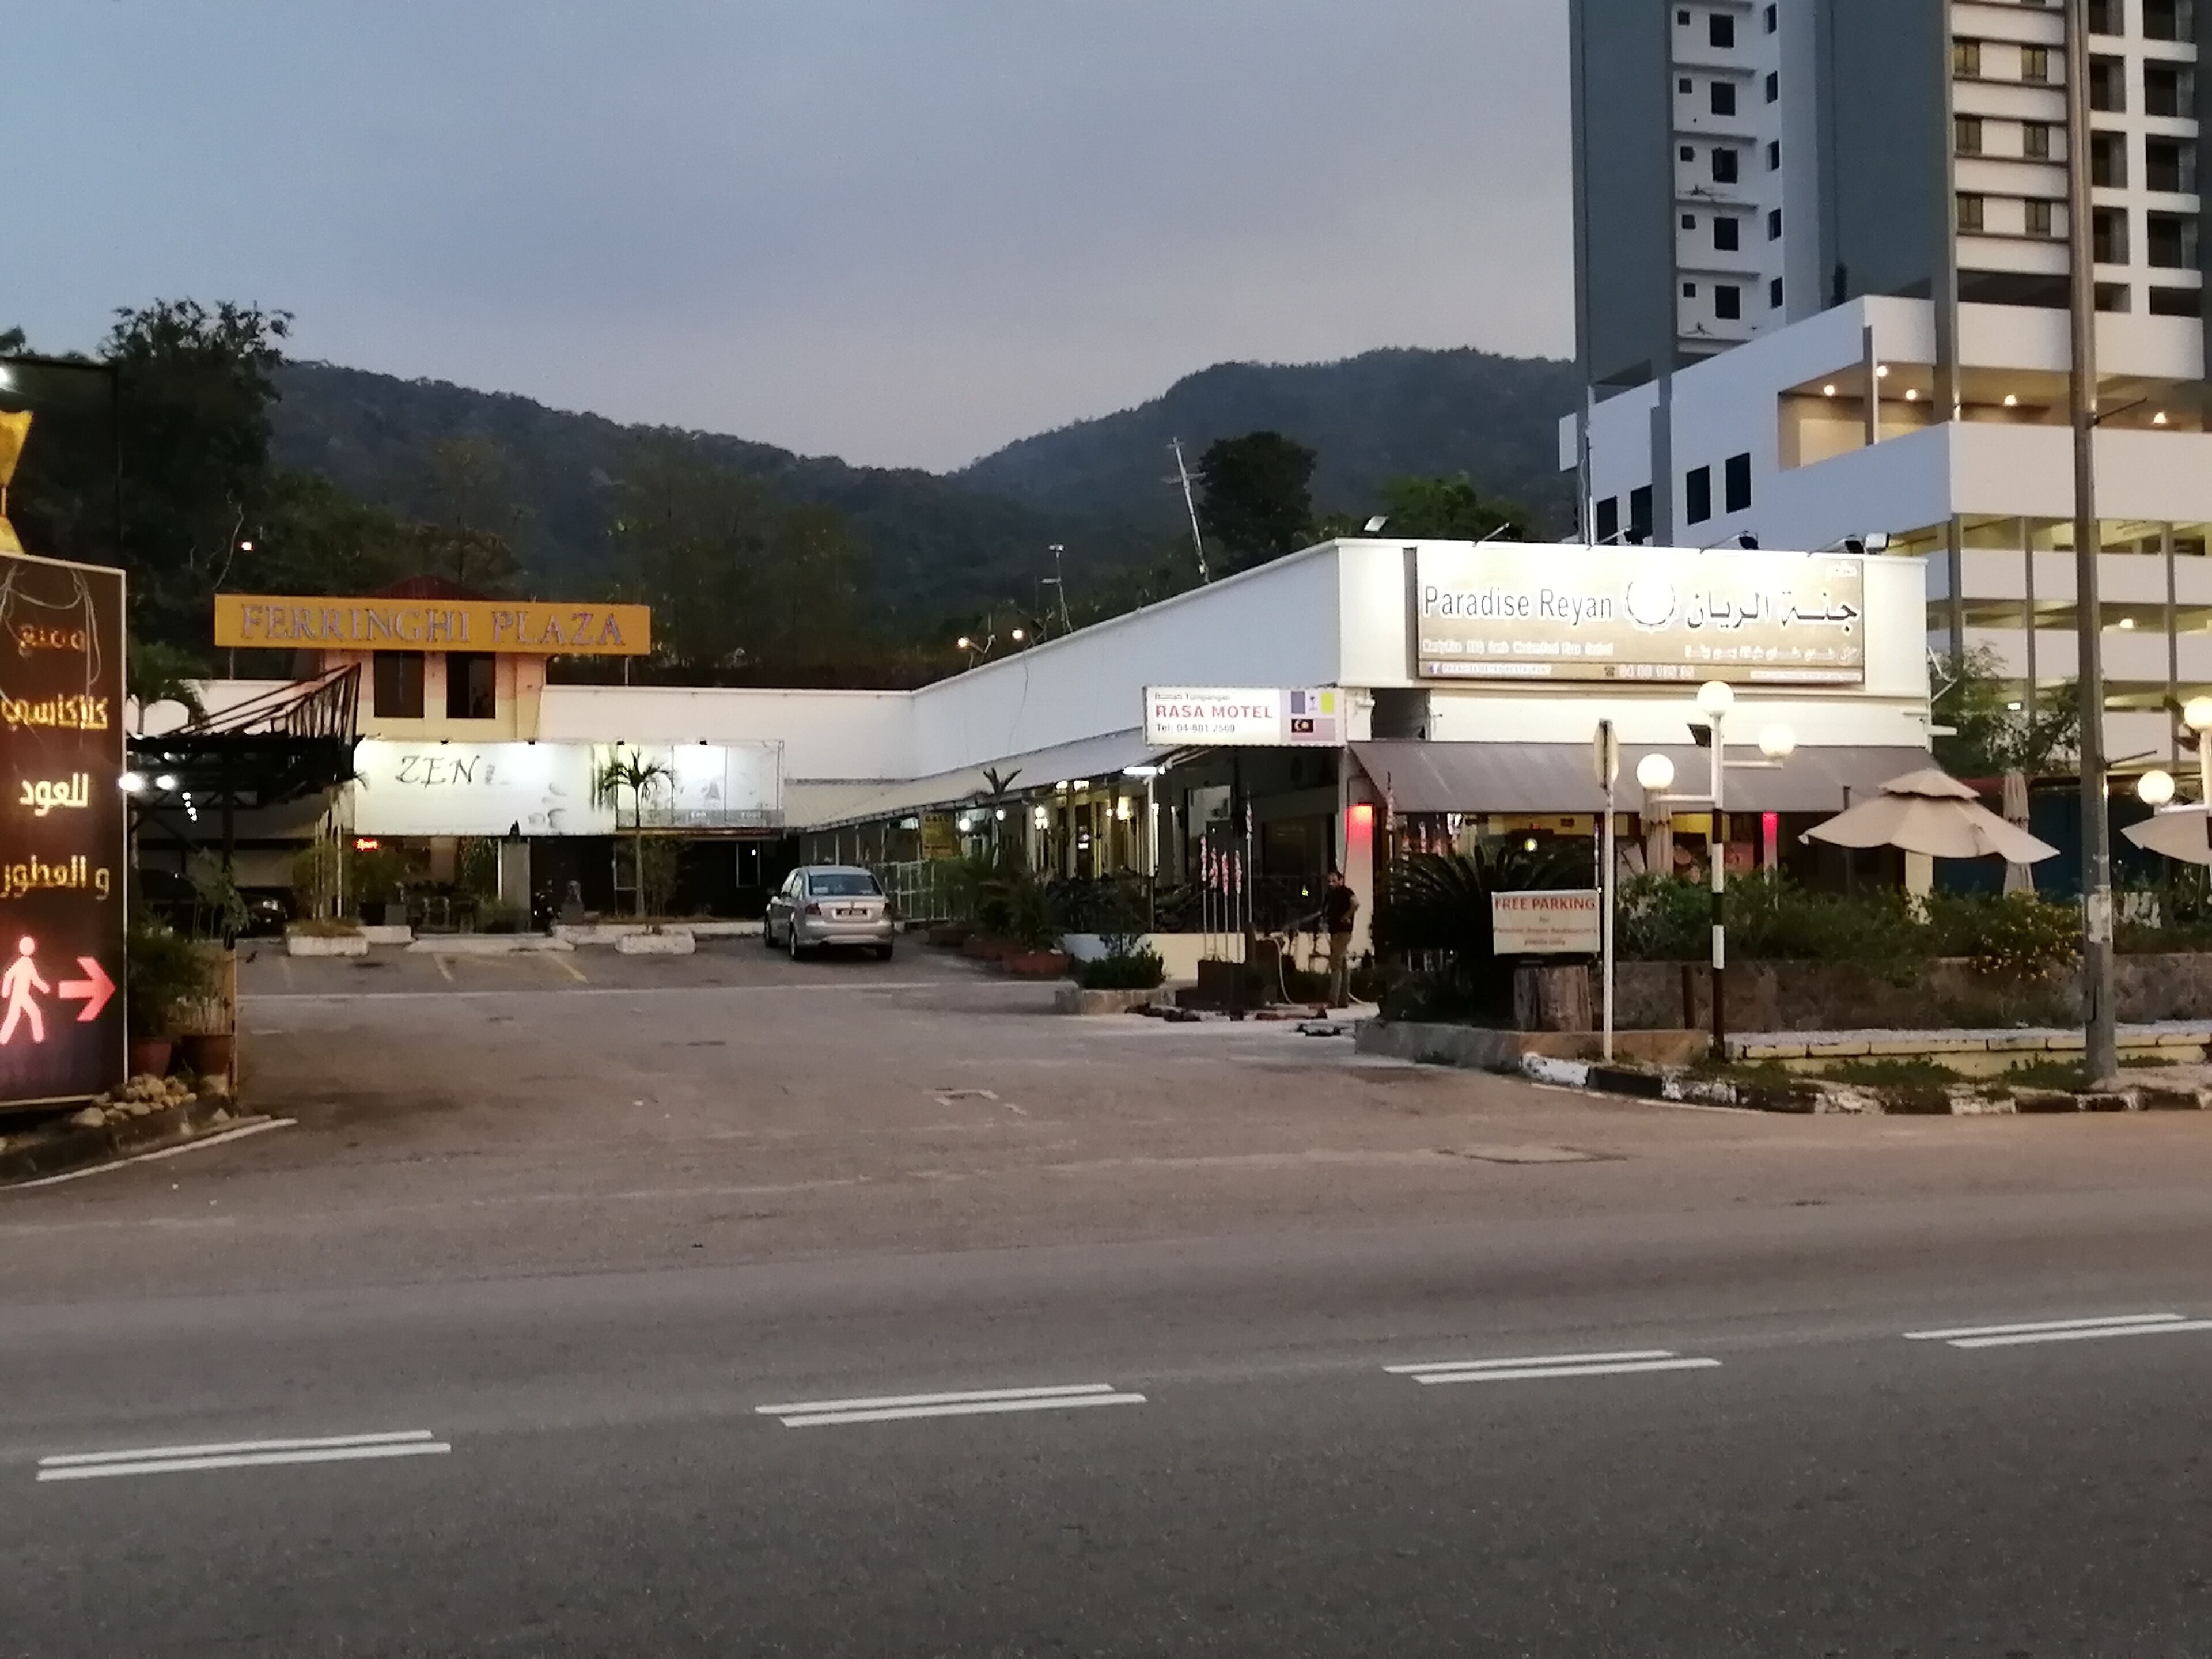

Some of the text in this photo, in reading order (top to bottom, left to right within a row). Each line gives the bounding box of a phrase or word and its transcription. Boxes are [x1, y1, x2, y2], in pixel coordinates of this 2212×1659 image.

[241, 603, 624, 646] FERRINGHI PLAZA
[1425, 585, 1612, 626] Paradise Reyan
[1687, 590, 1857, 632] جنة الريان
[1155, 704, 1274, 719] RASA MOTEL
[395, 755, 480, 789] ZEN
[19, 772, 89, 817] للعود
[0, 854, 110, 901] و العطور
[1495, 897, 1596, 911] FREE PARKING
